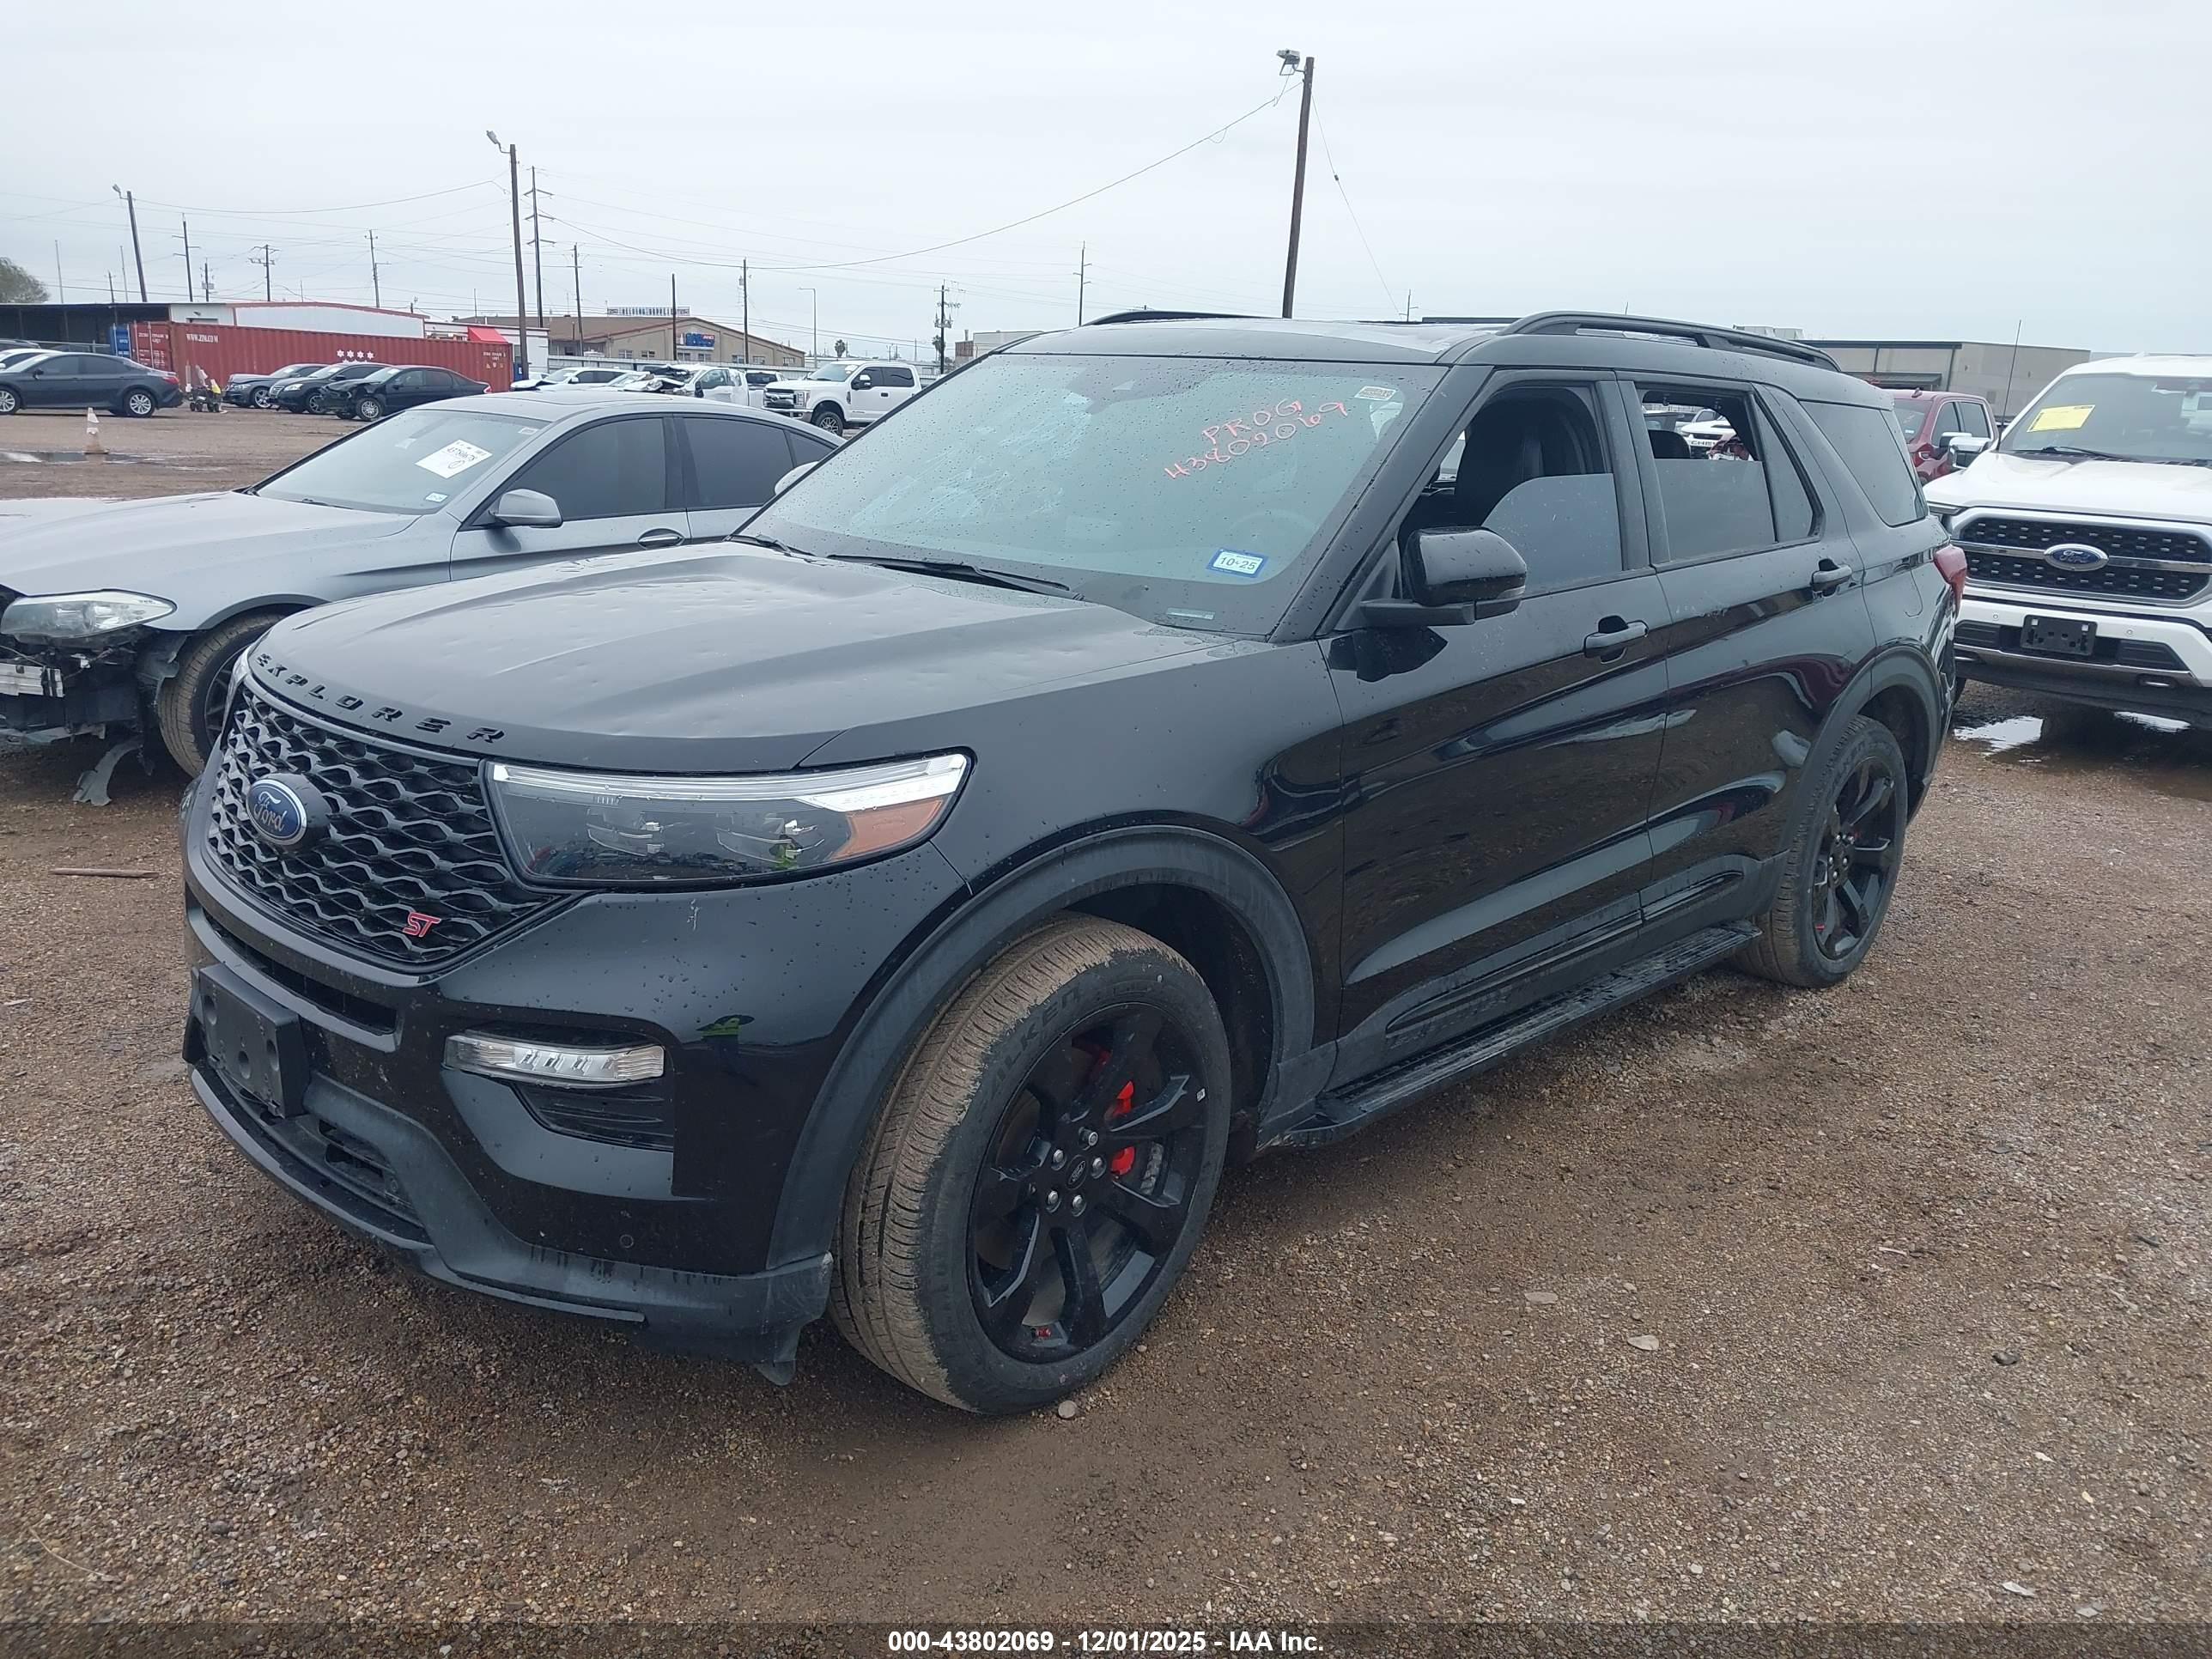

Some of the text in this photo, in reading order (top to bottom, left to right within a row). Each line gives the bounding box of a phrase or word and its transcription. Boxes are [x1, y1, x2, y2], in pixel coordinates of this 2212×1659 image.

[1164, 401, 1348, 479] 43802069
[256, 653, 506, 744] EXPLORER
[253, 790, 289, 832] Ford
[402, 911, 442, 938] ST
